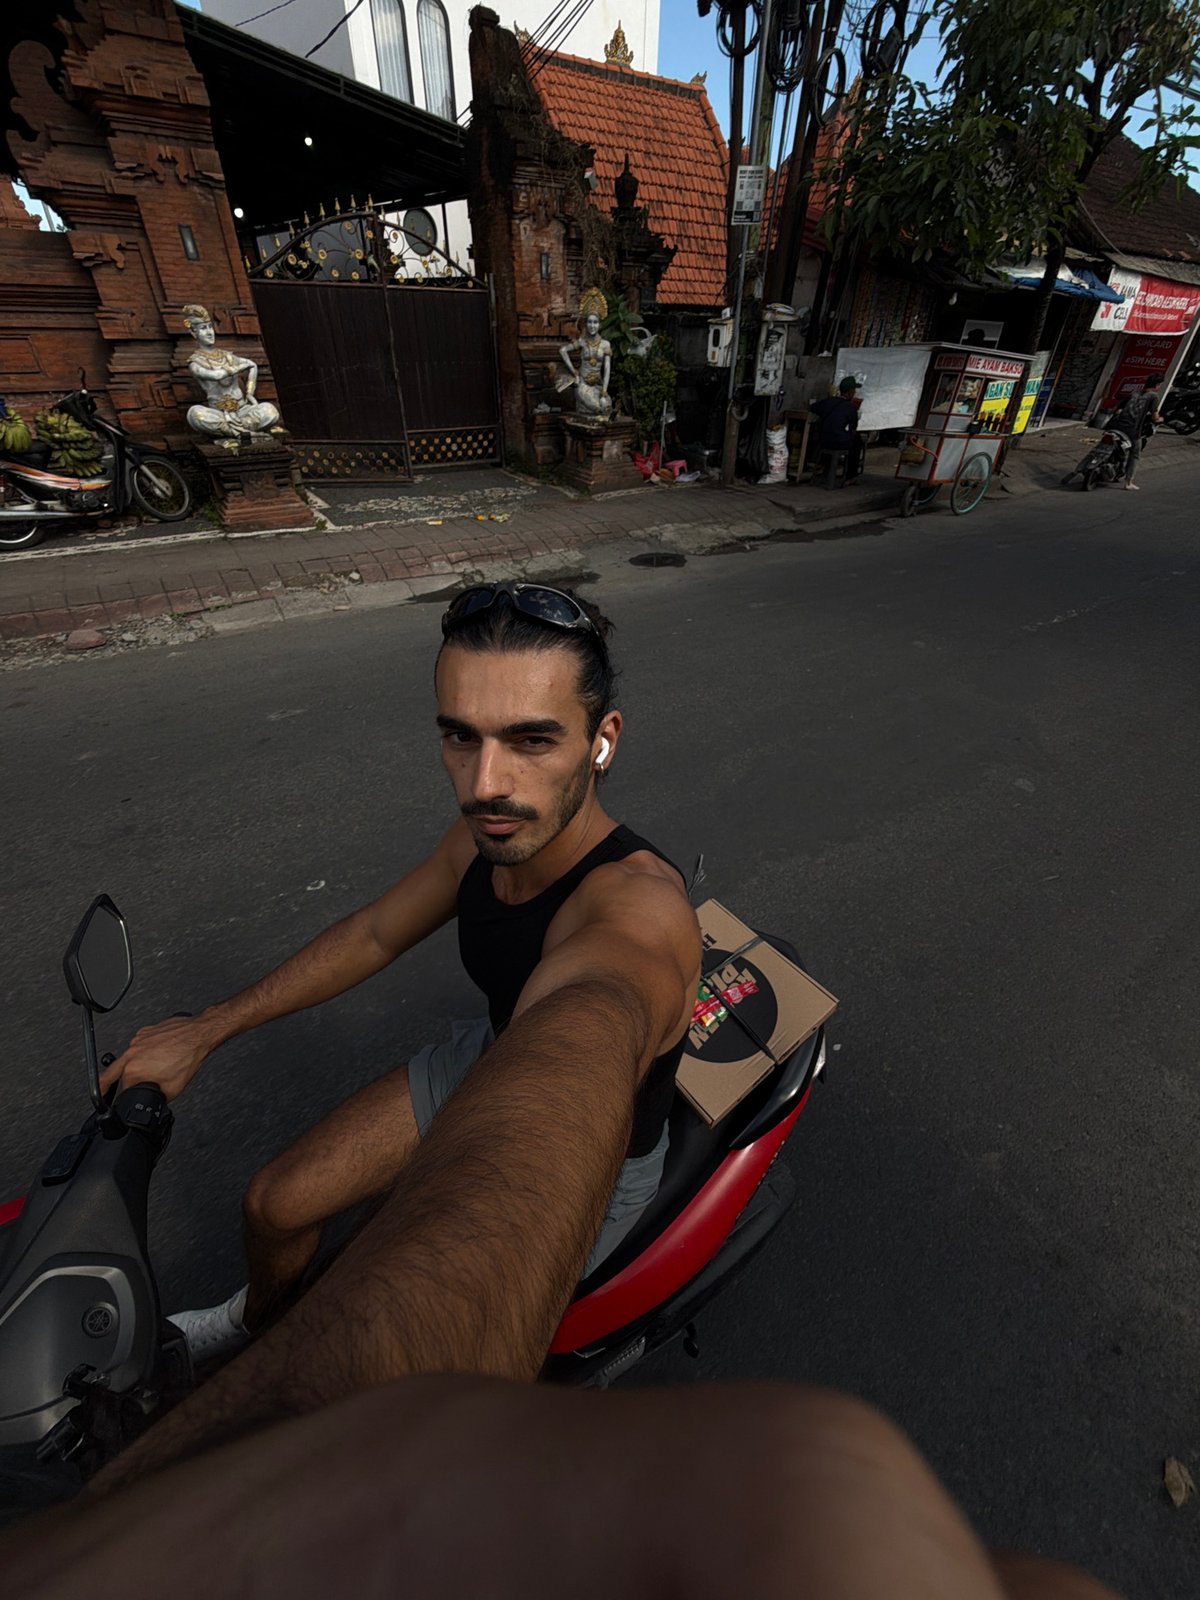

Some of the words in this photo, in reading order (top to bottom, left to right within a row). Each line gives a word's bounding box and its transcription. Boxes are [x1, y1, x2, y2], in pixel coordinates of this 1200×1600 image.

[1135, 339, 1173, 349] SIMCARD
[967, 355, 982, 369] MIE
[979, 358, 1001, 373] AYAM
[1000, 360, 1025, 375] BAKSO
[1143, 357, 1168, 367] HERE
